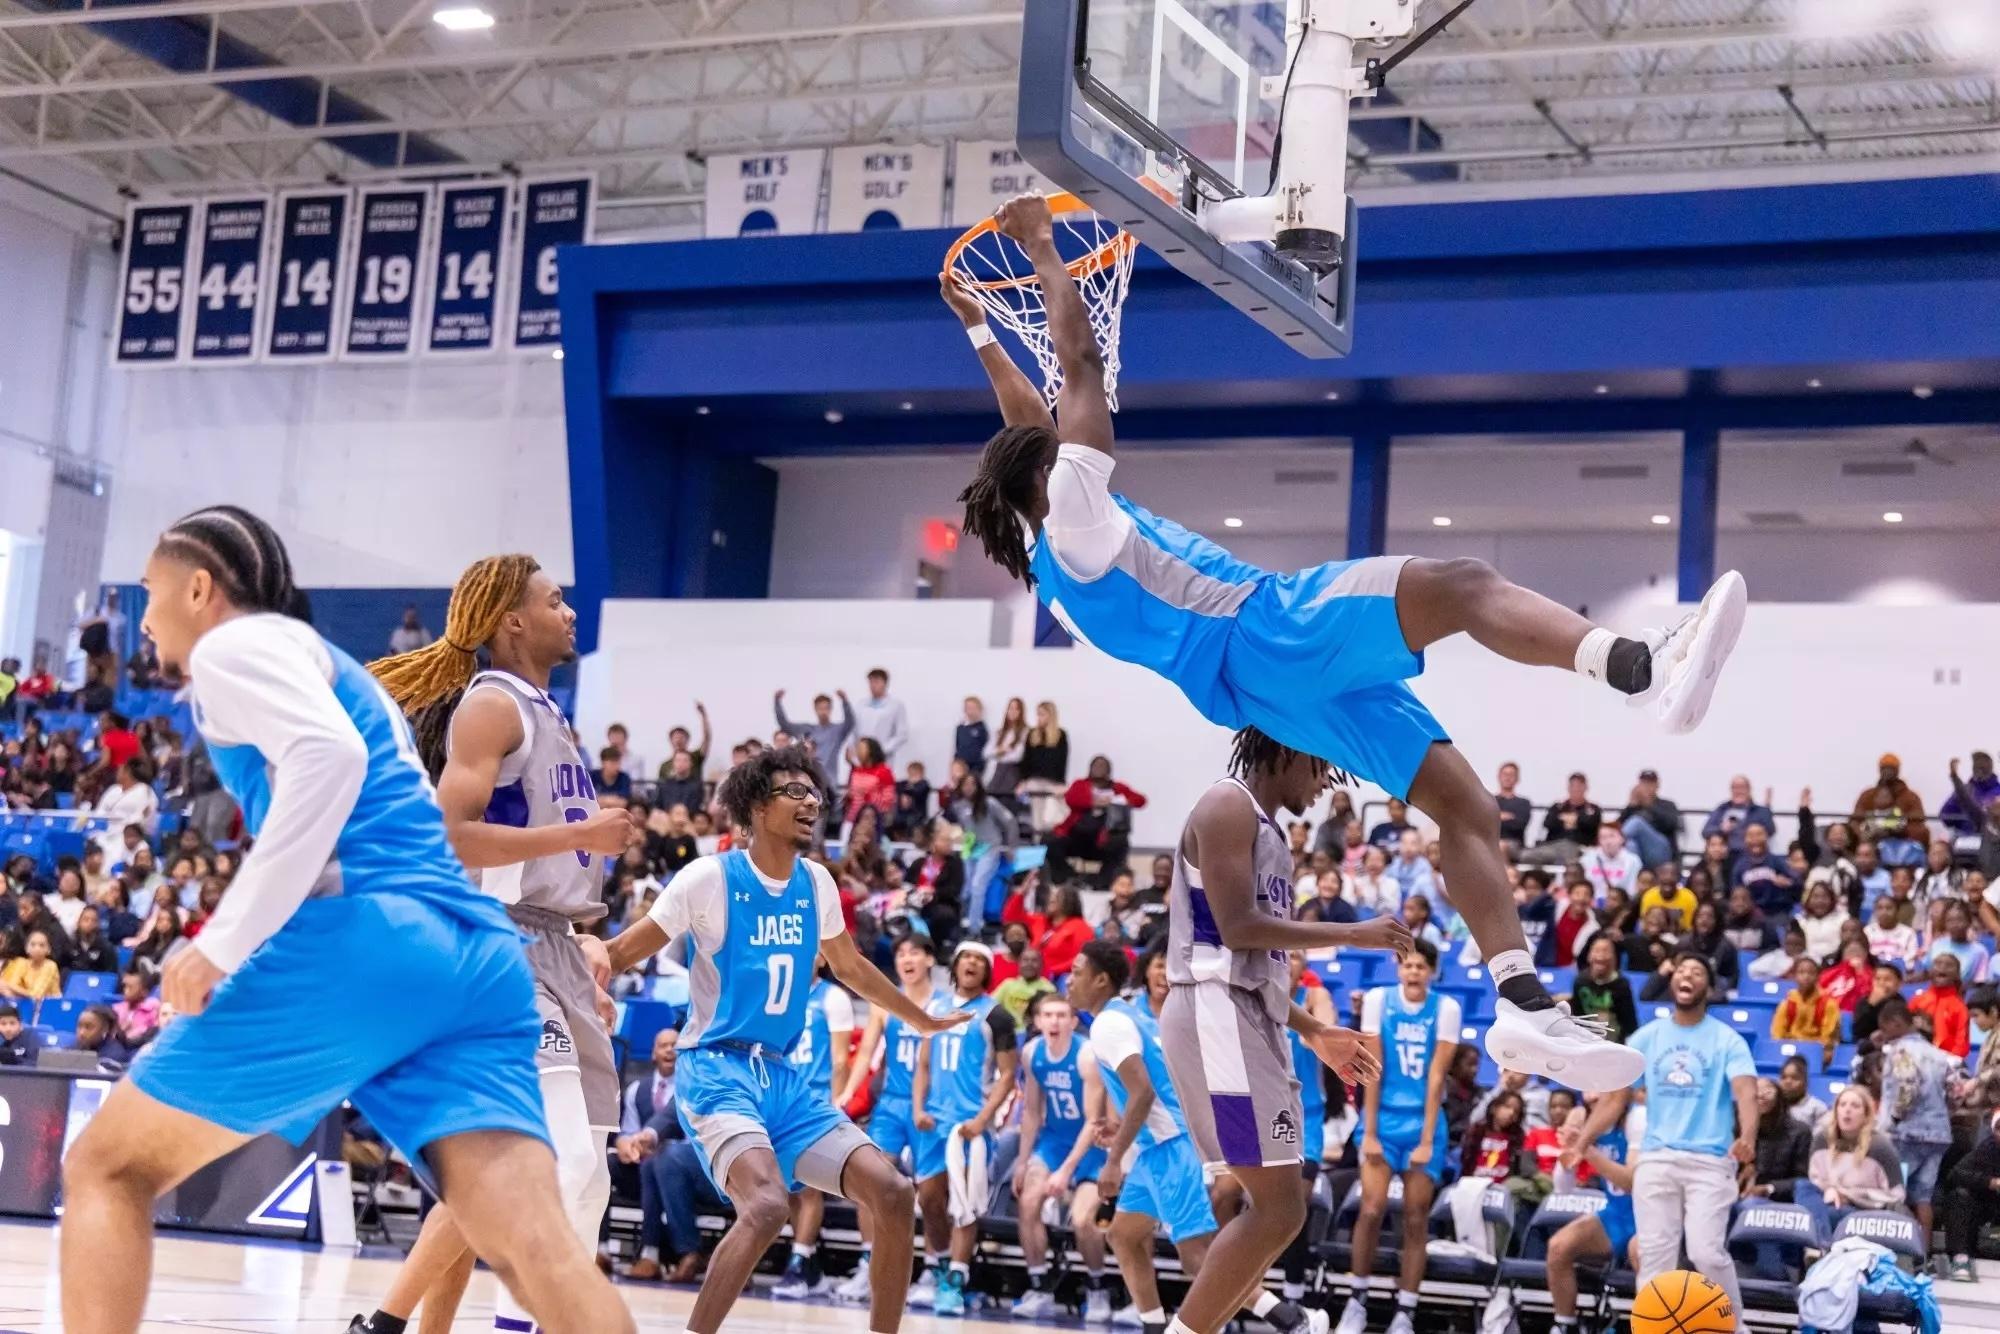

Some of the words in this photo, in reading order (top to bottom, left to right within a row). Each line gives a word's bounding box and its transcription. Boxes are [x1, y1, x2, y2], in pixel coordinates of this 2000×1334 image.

[741, 156, 789, 178] MEN'S
[864, 153, 913, 172] MEN'S
[990, 150, 1023, 167] MEN
[744, 182, 780, 203] GOLF
[863, 181, 908, 199] GOLF
[990, 175, 1036, 194] GOLF
[127, 266, 182, 314] 55
[200, 262, 258, 311] 44
[282, 258, 331, 307] 14
[361, 254, 412, 304] 19
[441, 251, 493, 300] 14
[548, 763, 596, 803] LION
[749, 913, 803, 946] JAGS
[764, 953, 795, 1015] 0
[539, 1032, 572, 1053] PC
[896, 1039, 921, 1073] 4
[939, 1034, 961, 1073] 11
[1396, 1043, 1426, 1081] 15
[1047, 1090, 1081, 1120] 13
[1743, 1208, 1812, 1233] AUGUSTA
[1844, 1216, 1914, 1241] AUGUSTA
